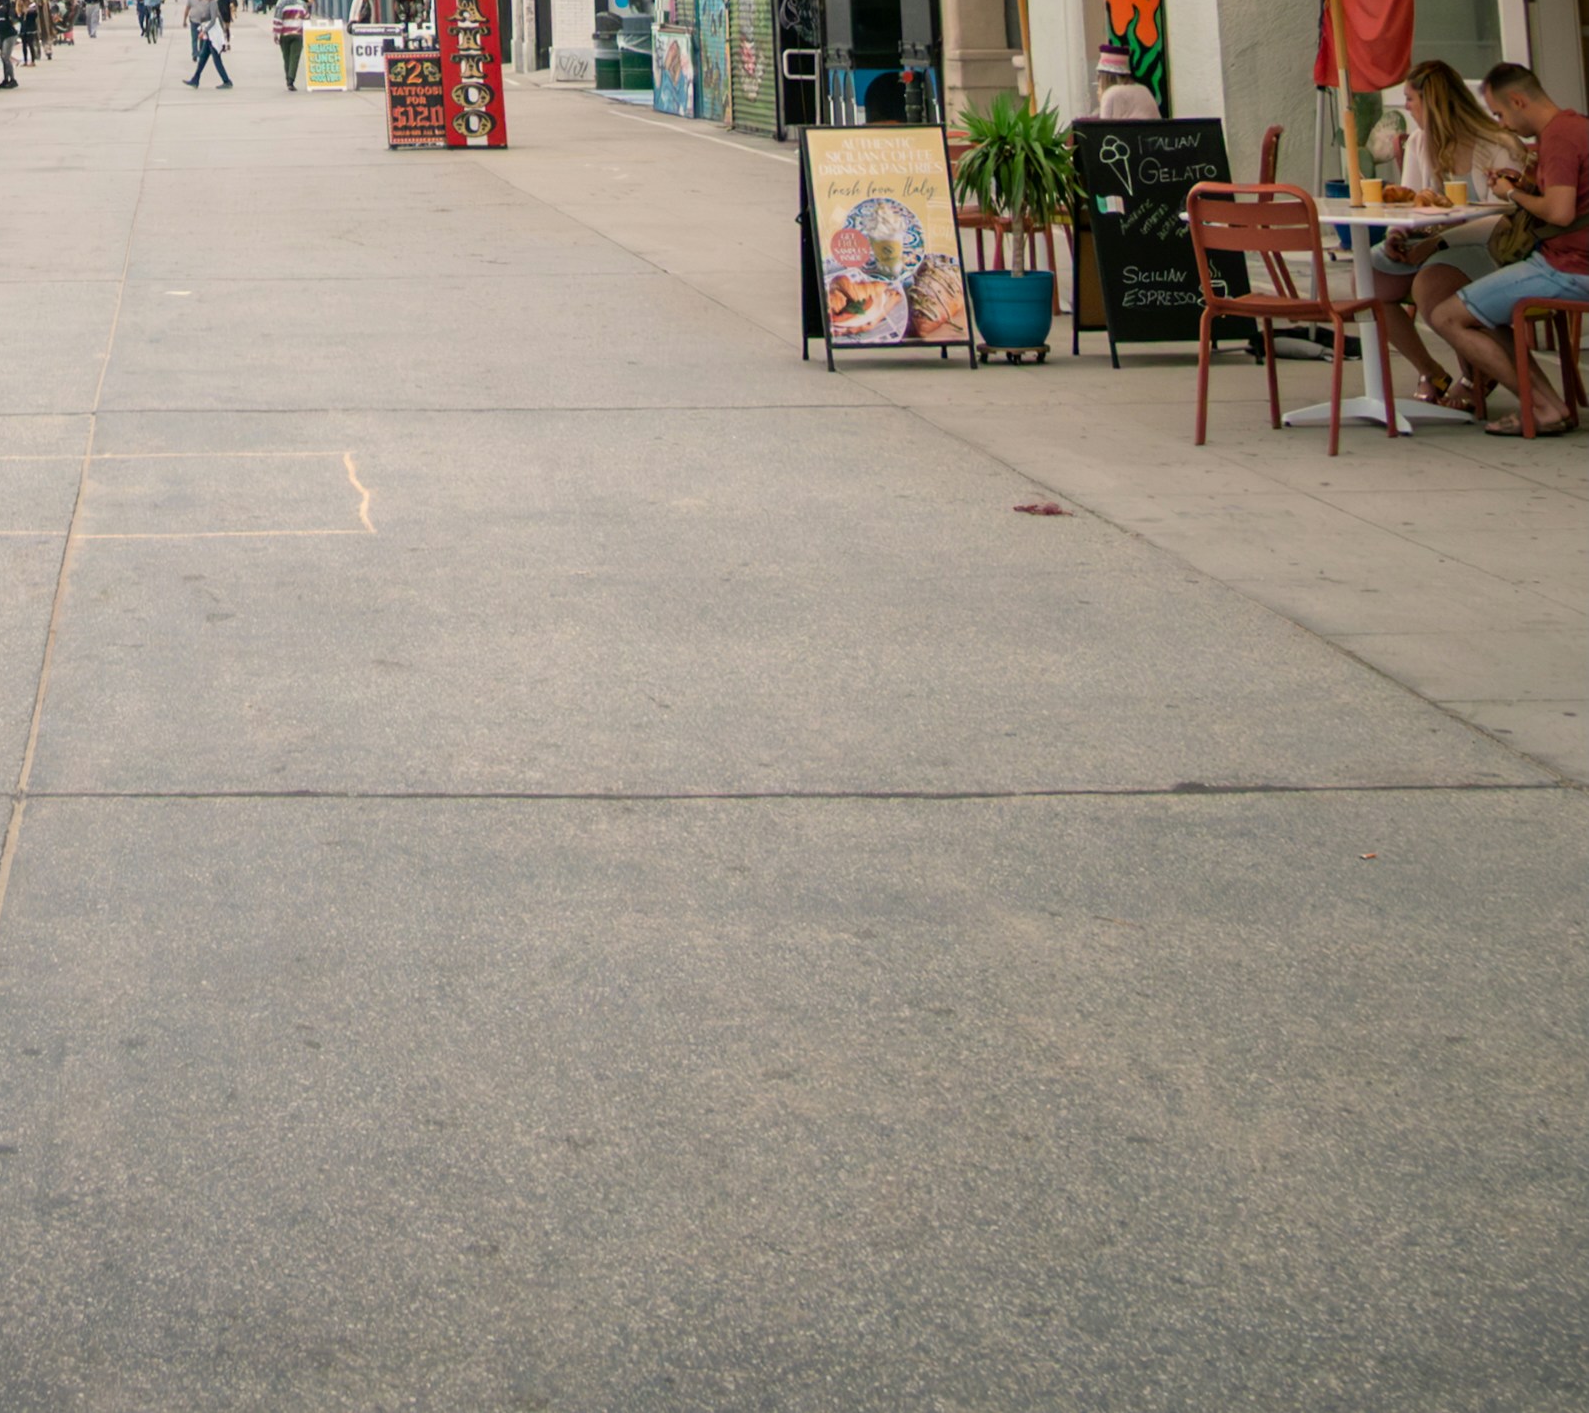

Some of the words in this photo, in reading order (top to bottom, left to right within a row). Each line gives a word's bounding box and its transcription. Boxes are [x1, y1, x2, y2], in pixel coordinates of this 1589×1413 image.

[406, 60, 423, 84] 2
[406, 96, 427, 105] FOR
[392, 105, 444, 128] $120
[841, 137, 915, 150] AUTHENTIC
[1138, 133, 1201, 154] ITALIAN
[825, 150, 879, 163] SICILIAN
[881, 149, 932, 162] COFFEE
[818, 164, 866, 176] DRINKS
[869, 163, 879, 175] &
[881, 161, 943, 175] PASTRIES
[1138, 157, 1217, 184] GELATO
[827, 179, 860, 198] fresh
[867, 181, 895, 197] from
[902, 177, 936, 199] Italy
[1122, 265, 1187, 284] SICILIAN
[1122, 288, 1197, 307] ESPRESSO
